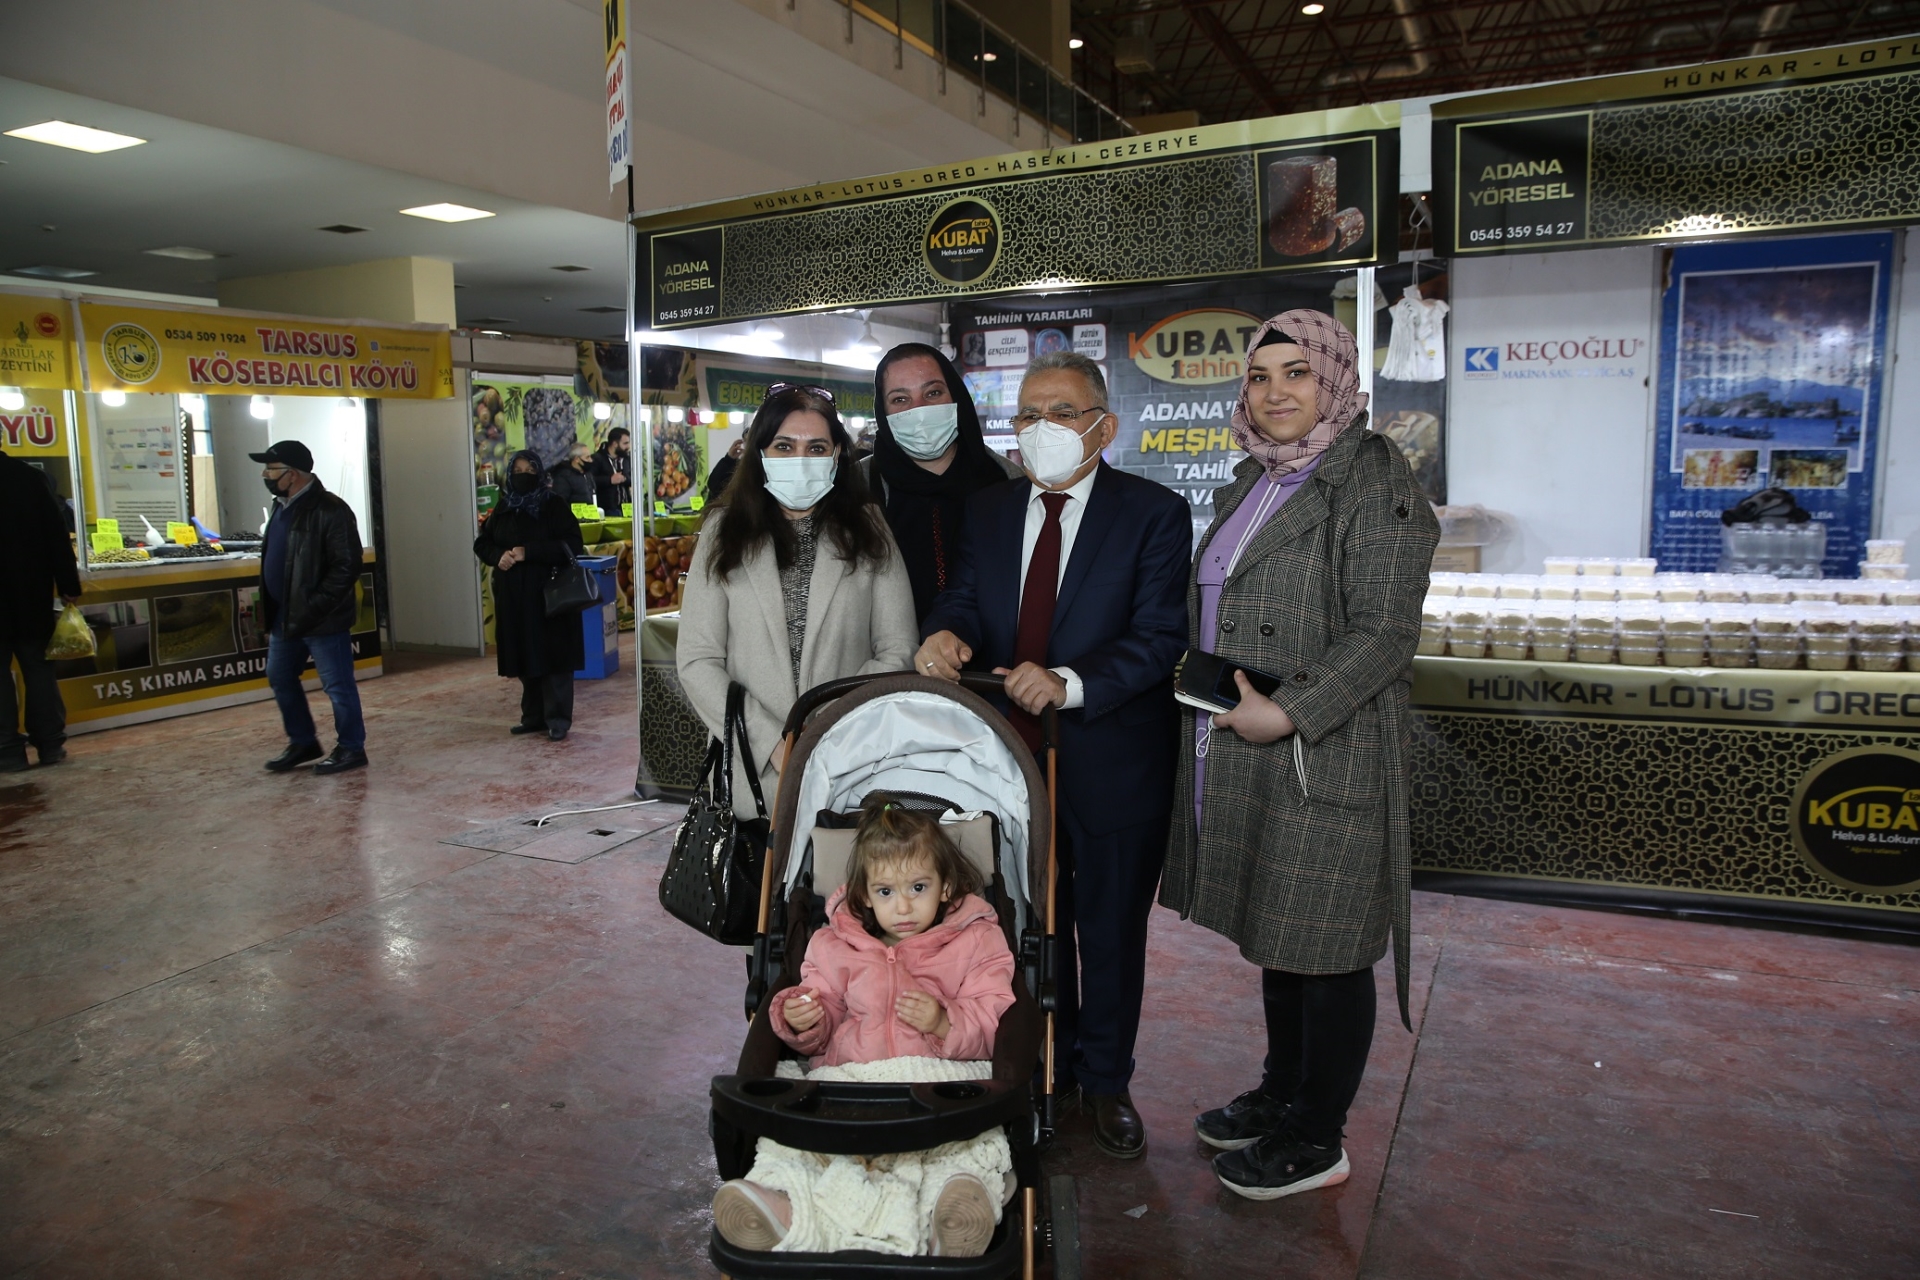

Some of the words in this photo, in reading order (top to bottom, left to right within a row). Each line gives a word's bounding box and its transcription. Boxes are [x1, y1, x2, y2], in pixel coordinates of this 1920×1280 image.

[1664, 60, 1798, 89] HÜNKAR
[753, 190, 825, 210] HÜNKAR
[842, 178, 903, 196] LOTUS
[923, 165, 976, 184] OREO
[997, 151, 1076, 172] HASEKİ
[1100, 134, 1199, 160] CEZERYE
[1480, 158, 1564, 182] ADANA
[1468, 182, 1575, 207] YÖRESEL
[929, 228, 990, 250] KUBAT
[1470, 228, 1503, 242] 0545
[1506, 225, 1532, 239] 359
[1536, 223, 1553, 237] 54
[1556, 222, 1574, 235] 27
[963, 247, 984, 256] Lokum
[664, 260, 710, 277] ADANA
[659, 276, 716, 295] YÖRESEL
[660, 310, 678, 320] 0545
[680, 308, 693, 318] 359
[694, 306, 704, 316] 54
[705, 305, 715, 315] 27
[975, 311, 1023, 326] TAHİNİN
[1025, 308, 1093, 322] YARARLARI
[165, 329, 193, 340] 0534
[197, 331, 216, 342] 509
[221, 333, 246, 344] 1924
[257, 327, 357, 358] TARSUS
[1127, 326, 1257, 359] KUBAT
[1, 358, 52, 373] ZEYTİNİ
[188, 351, 342, 388] KÖSEBALCI
[349, 359, 417, 390] KÖYÜ
[93, 680, 133, 699] TAŞ
[140, 668, 206, 692] KIRMA
[212, 657, 267, 679] SARIU
[1468, 675, 1613, 705] HÜNKAR
[1649, 683, 1774, 712] LOTUS
[1808, 799, 1920, 831] KUBA
[1832, 830, 1865, 841] Helva
[1867, 832, 1877, 842] &
